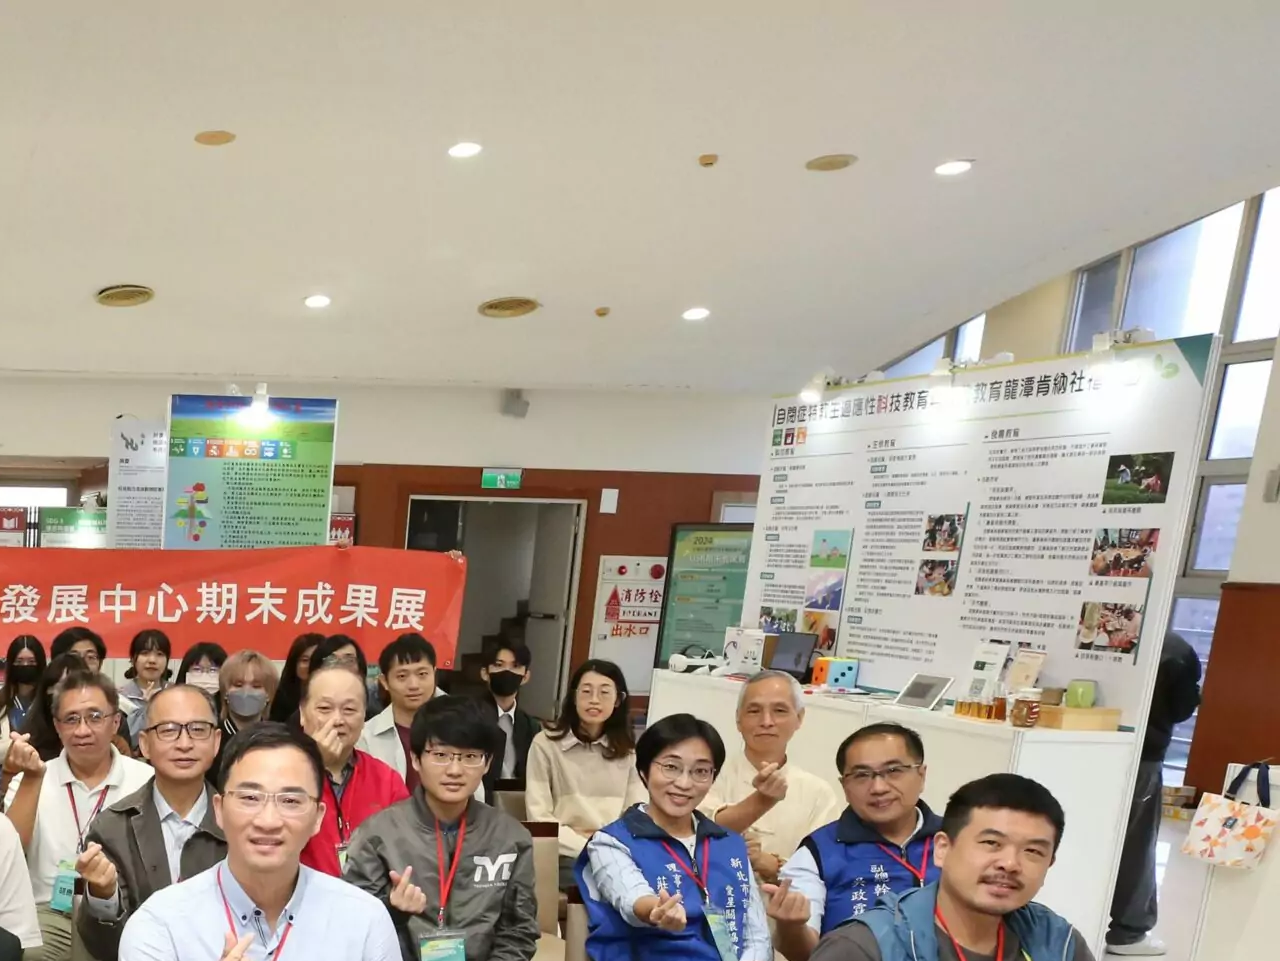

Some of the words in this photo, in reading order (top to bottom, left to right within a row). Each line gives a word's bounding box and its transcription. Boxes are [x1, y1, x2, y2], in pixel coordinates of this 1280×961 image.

[621, 588, 662, 603] 消防栓
[610, 624, 650, 638] 出水口
